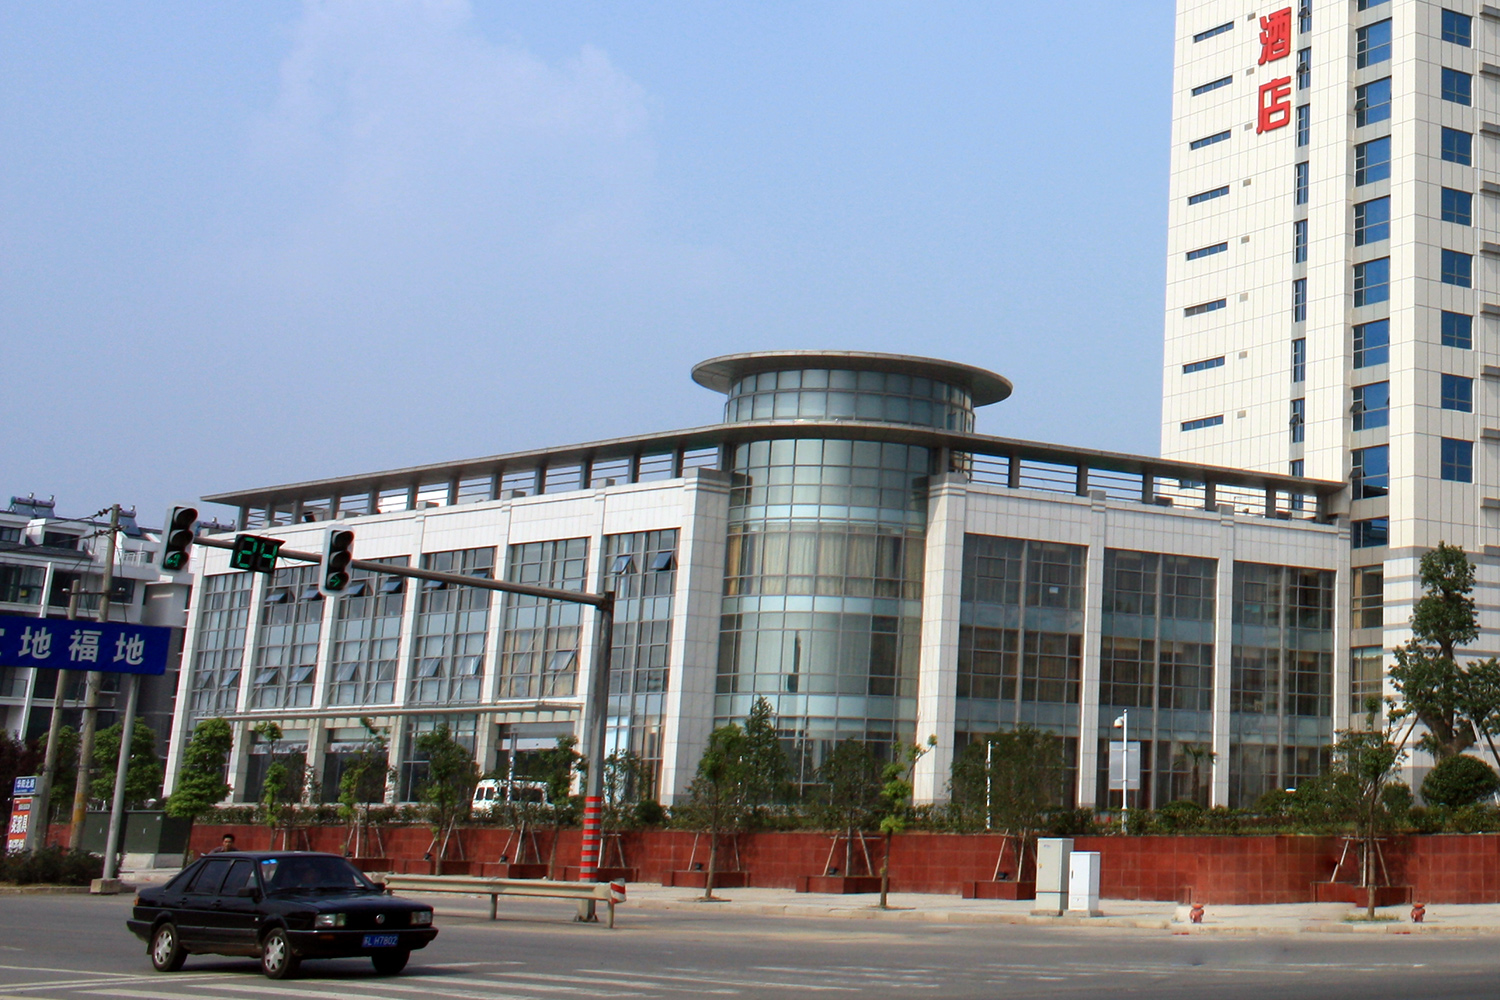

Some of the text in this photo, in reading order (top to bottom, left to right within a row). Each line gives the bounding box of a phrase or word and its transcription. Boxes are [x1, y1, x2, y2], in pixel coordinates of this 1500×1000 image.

[237, 537, 278, 569] 24
[0, 625, 145, 666] 地福地
